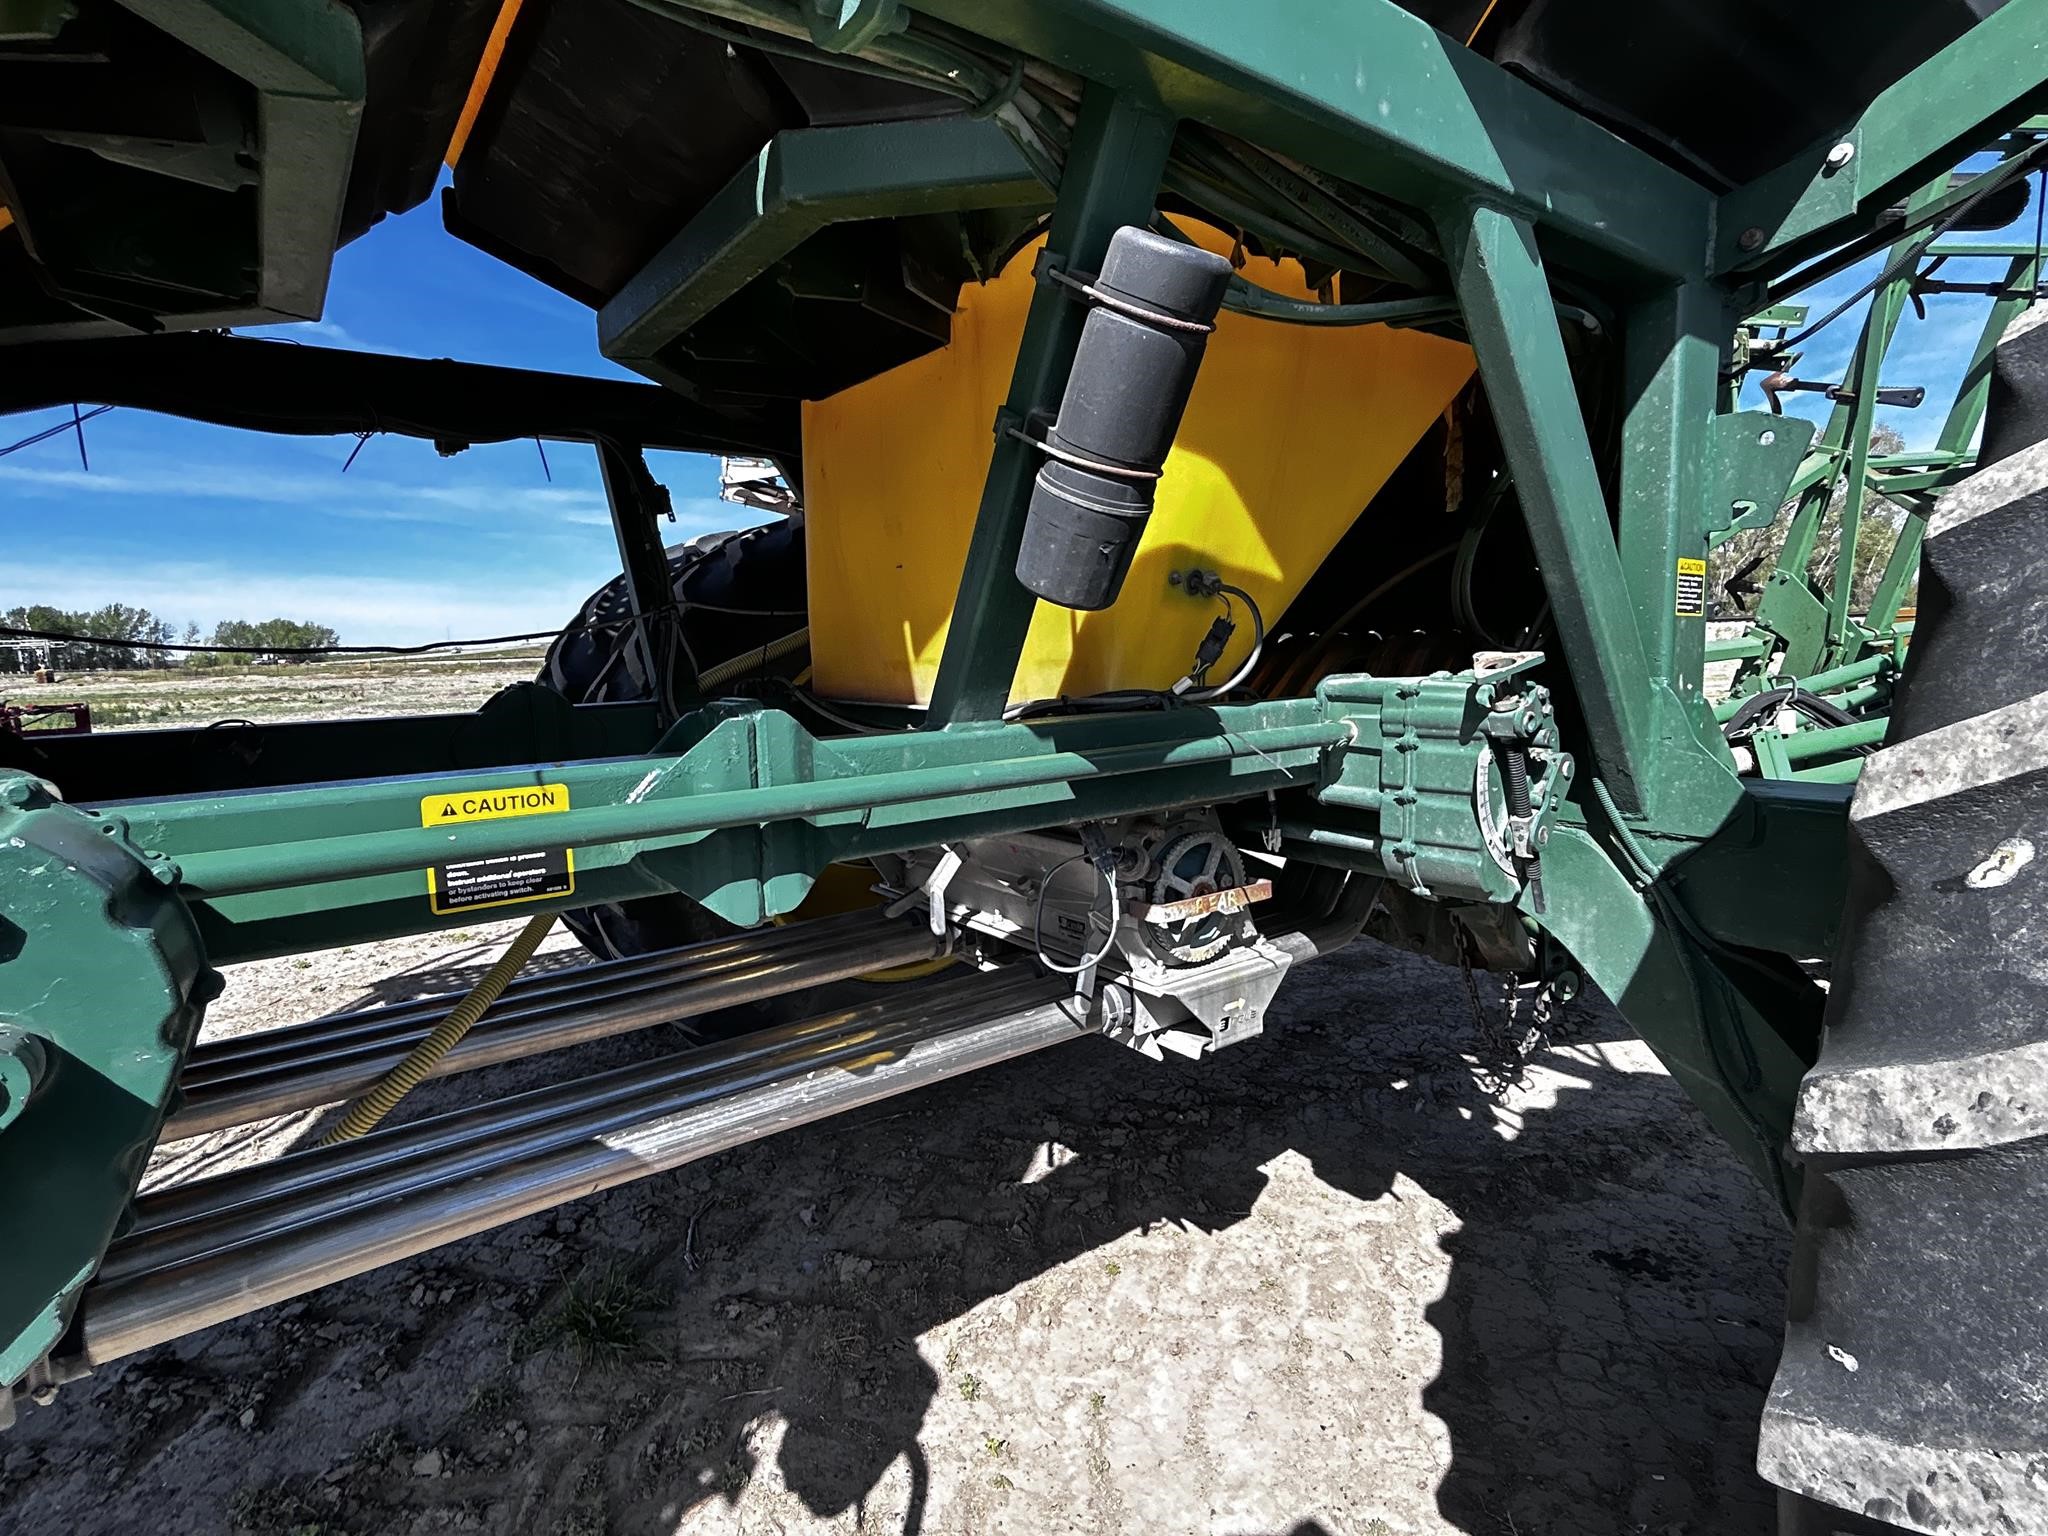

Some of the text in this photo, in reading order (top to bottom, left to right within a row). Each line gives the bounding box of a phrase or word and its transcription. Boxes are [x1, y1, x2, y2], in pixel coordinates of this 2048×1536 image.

[463, 792, 555, 814] CAUTION
[447, 868, 547, 887] Instruct additional operators
[457, 883, 498, 894] bystanders
[507, 879, 525, 887] keep
[525, 876, 543, 884] clear
[449, 886, 535, 904] before activating switch.
